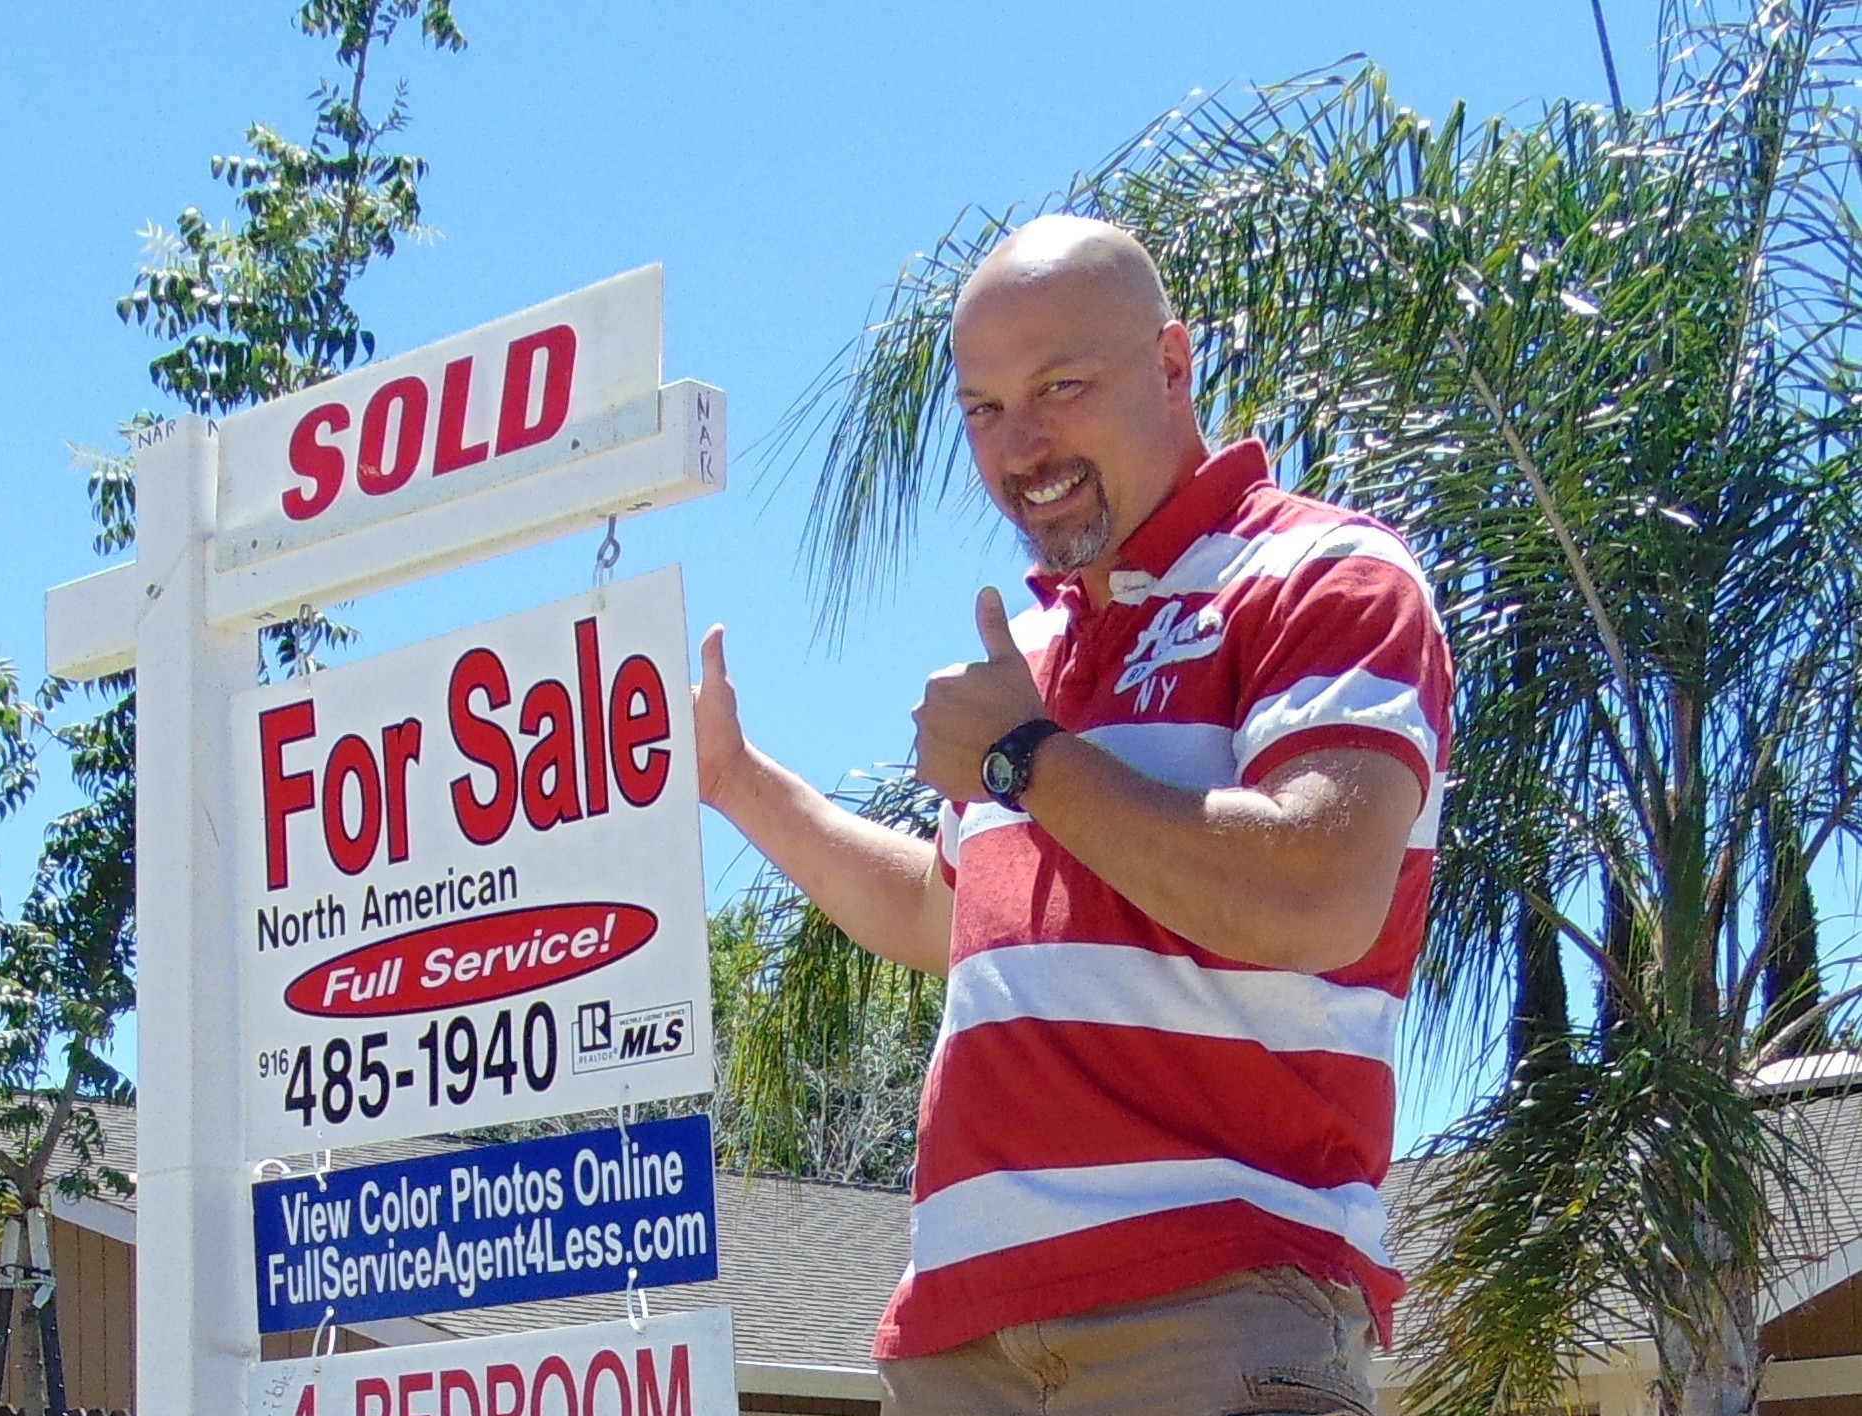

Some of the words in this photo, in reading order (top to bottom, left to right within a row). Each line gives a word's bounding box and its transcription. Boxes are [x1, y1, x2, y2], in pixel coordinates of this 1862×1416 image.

[138, 418, 176, 449] NAR
[281, 323, 576, 520] SOLD
[1133, 675, 1178, 714] NY
[259, 698, 421, 891] For
[448, 616, 671, 846] Sale
[257, 893, 346, 952] North
[361, 865, 518, 931] American
[322, 957, 403, 1007] Full
[421, 913, 617, 988] Service!
[258, 1048, 289, 1078] 916
[285, 1001, 558, 1127] 485-1940
[620, 1018, 685, 1060] MLS
[281, 1186, 351, 1247] View
[359, 1179, 441, 1234] Color
[450, 1161, 563, 1222] Photos
[574, 1143, 684, 1205] Online
[268, 1209, 708, 1307] FullServiceAgent4Less.com
